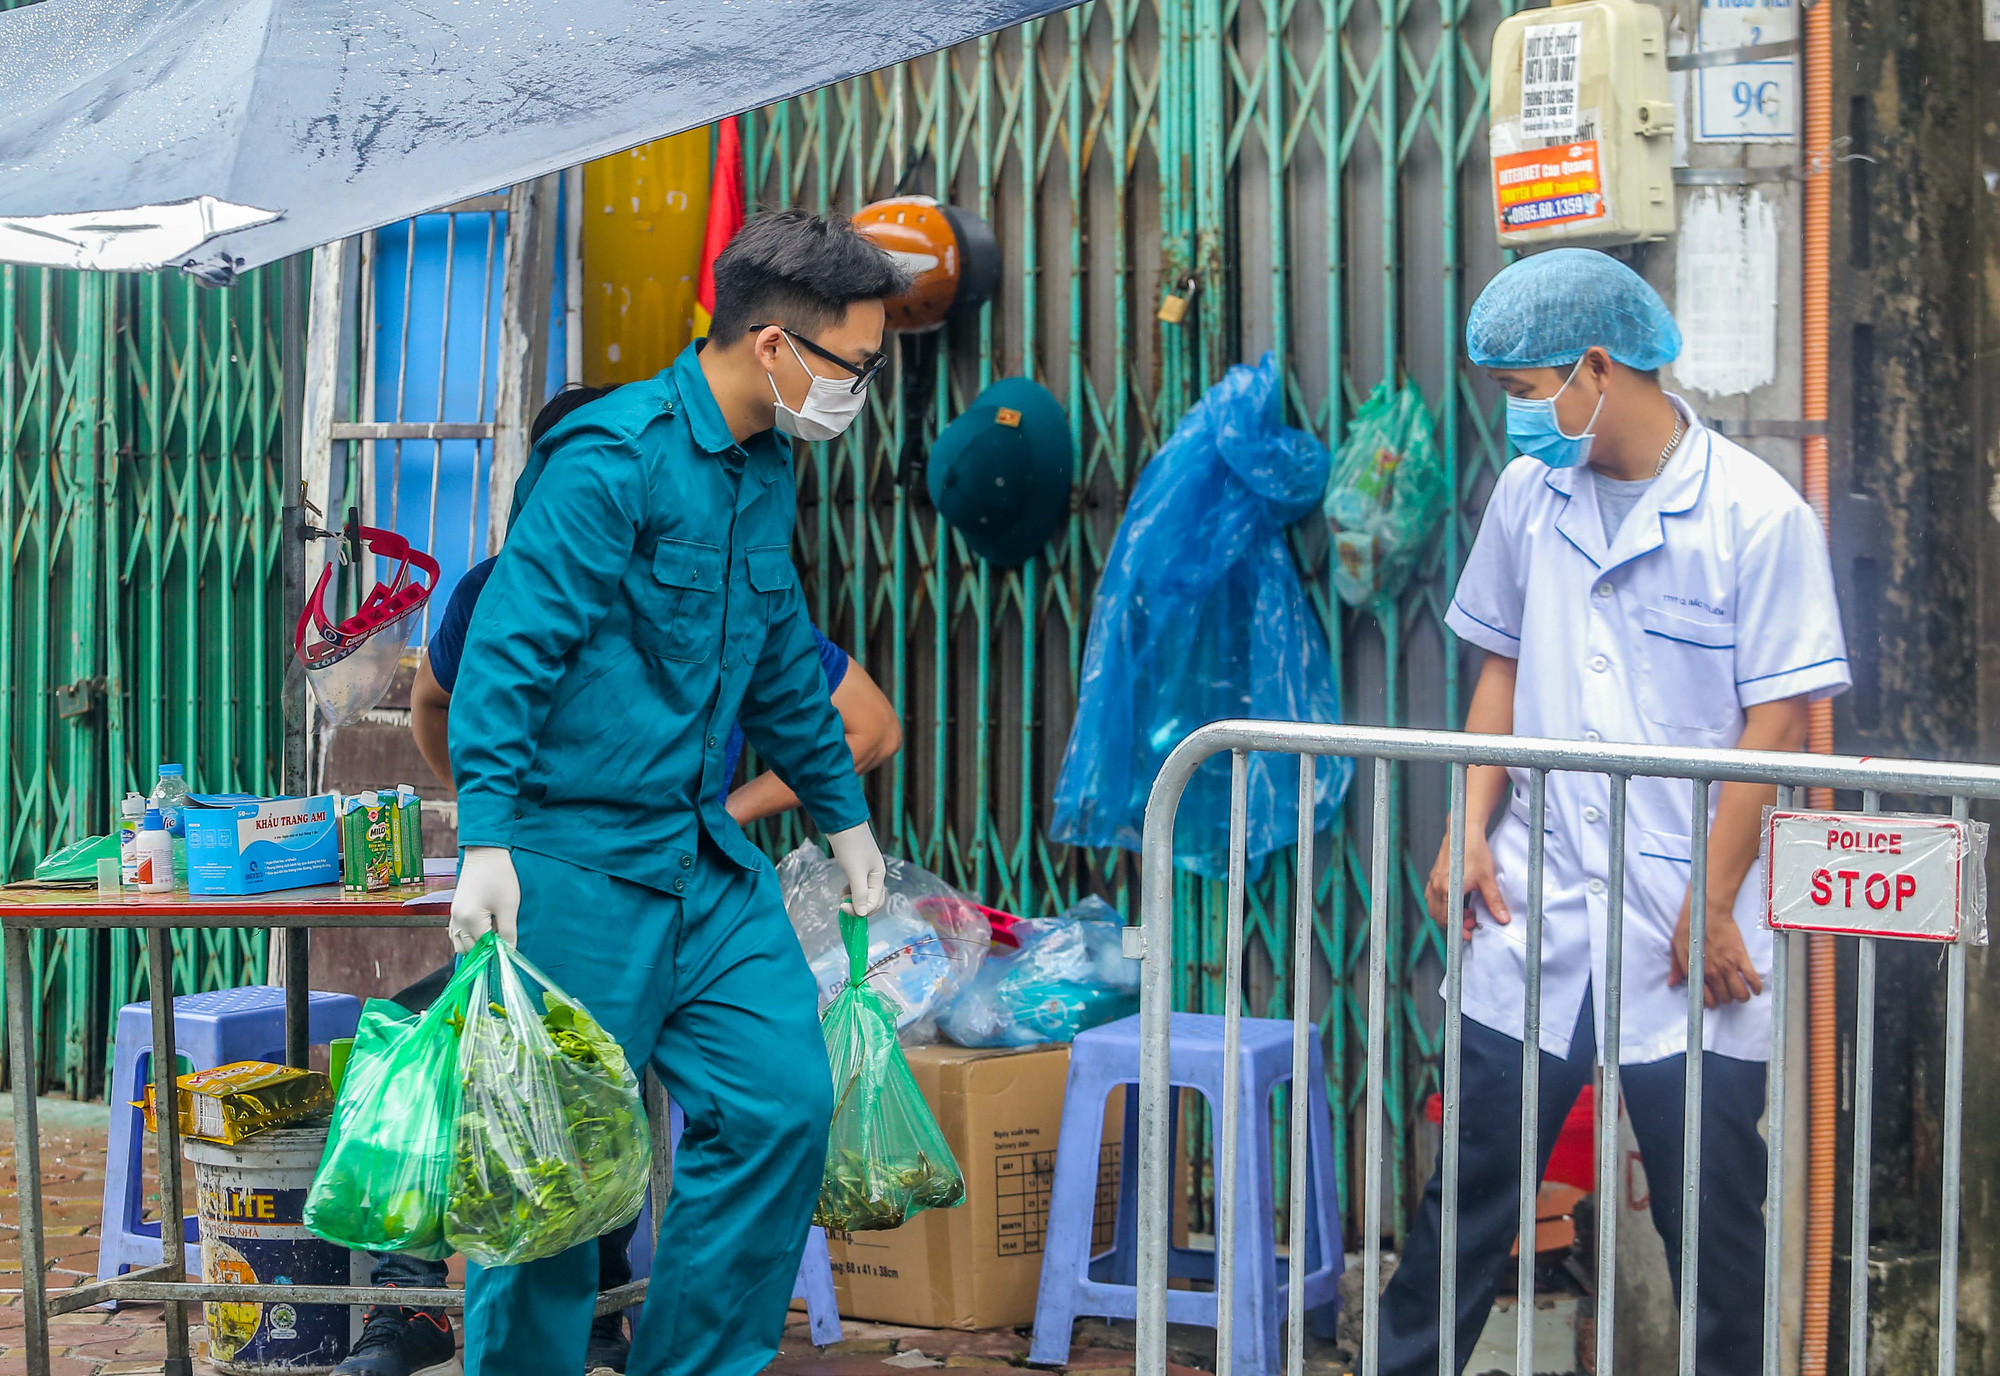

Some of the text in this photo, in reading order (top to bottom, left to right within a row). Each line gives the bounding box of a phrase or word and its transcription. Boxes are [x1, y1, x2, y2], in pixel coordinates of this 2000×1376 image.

[1499, 163, 1540, 185] INTERNET
[1511, 196, 1583, 224] 0865.60.1359
[255, 811, 326, 830] KHẨU TRANG AMI
[370, 826, 386, 837] MILO
[1827, 829, 1902, 854] POLICE
[1810, 868, 1917, 912] STOP
[863, 1264, 872, 1275] 41
